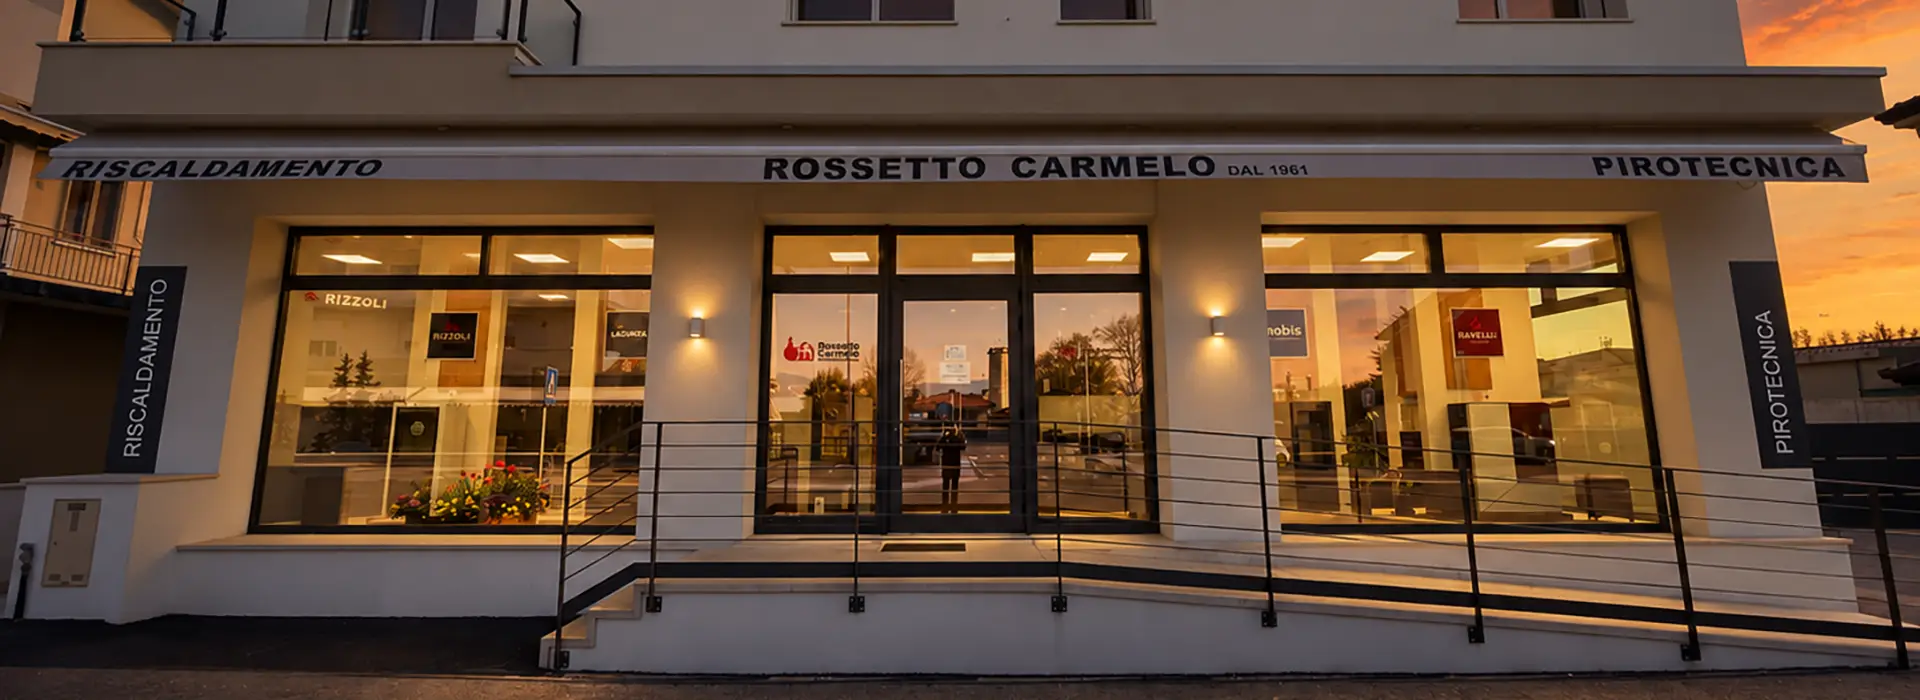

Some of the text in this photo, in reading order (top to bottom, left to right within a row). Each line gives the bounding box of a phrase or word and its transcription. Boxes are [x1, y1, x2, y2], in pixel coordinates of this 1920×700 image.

[62, 159, 383, 178] RISCALDAMENTO
[763, 155, 1309, 180] ROSSETTO CARMELO DAL 1961
[1591, 156, 1846, 178] PIROTECNICA
[324, 293, 387, 309] RIZZOLI
[123, 279, 168, 457] RISCALDAMENTO
[1755, 310, 1794, 454] PIROTECNICA
